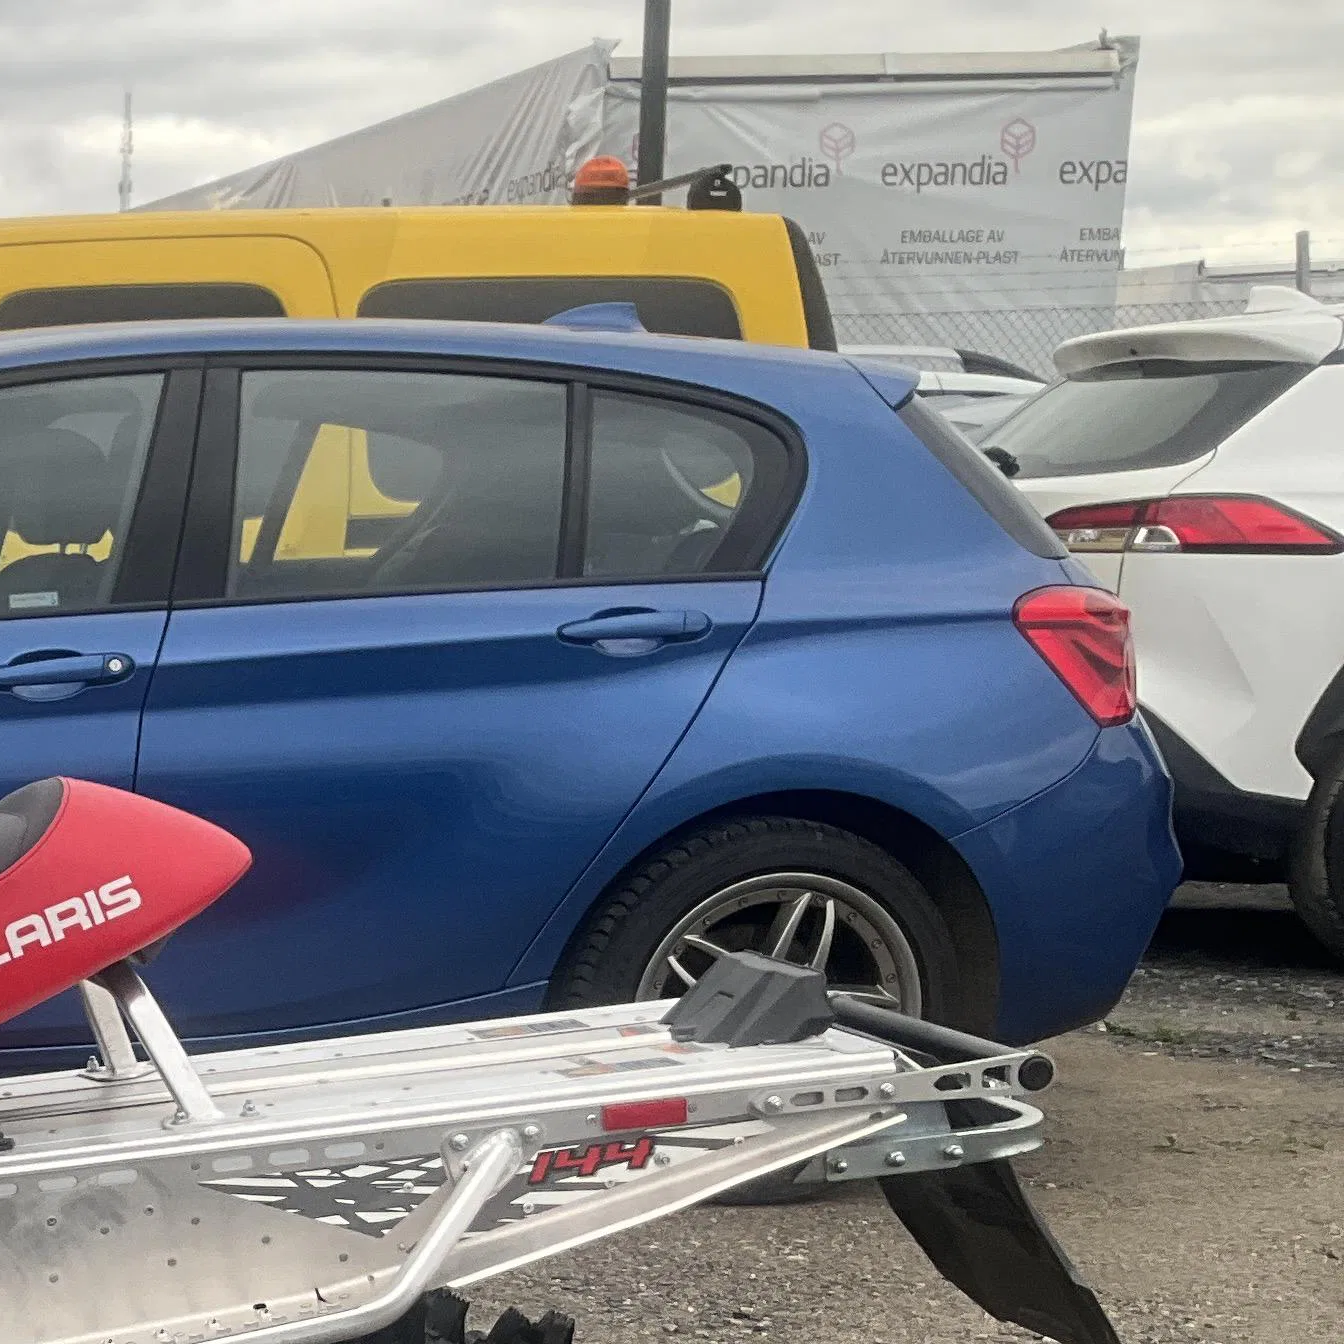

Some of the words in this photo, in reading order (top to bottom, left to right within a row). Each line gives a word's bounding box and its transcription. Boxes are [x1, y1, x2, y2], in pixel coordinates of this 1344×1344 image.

[881, 154, 1008, 194] expandia
[900, 229, 983, 244] EMBALLAGE
[986, 229, 1005, 242] AV
[973, 249, 1019, 265] PLAST
[528, 1135, 654, 1185] 144
